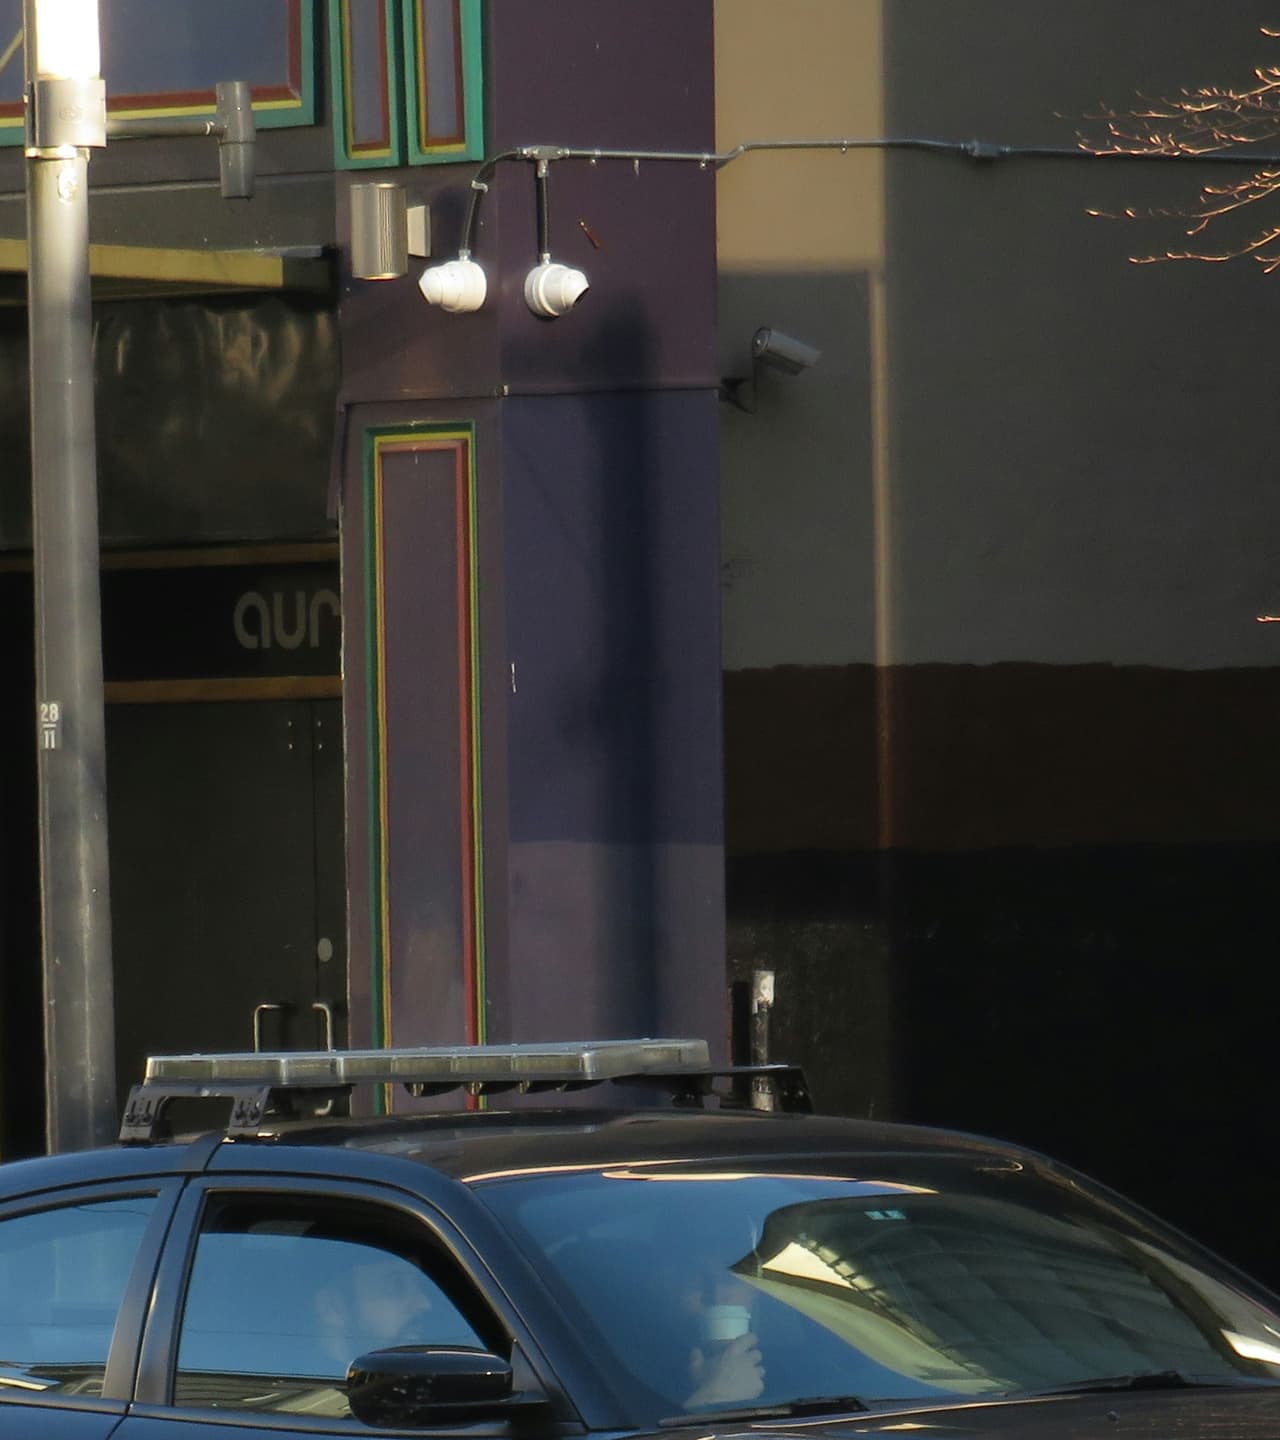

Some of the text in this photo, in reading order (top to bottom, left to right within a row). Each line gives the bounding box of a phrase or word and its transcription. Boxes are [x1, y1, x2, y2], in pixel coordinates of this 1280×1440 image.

[233, 589, 341, 650] aur
[40, 703, 59, 722] 28
[43, 729, 56, 749] 11
